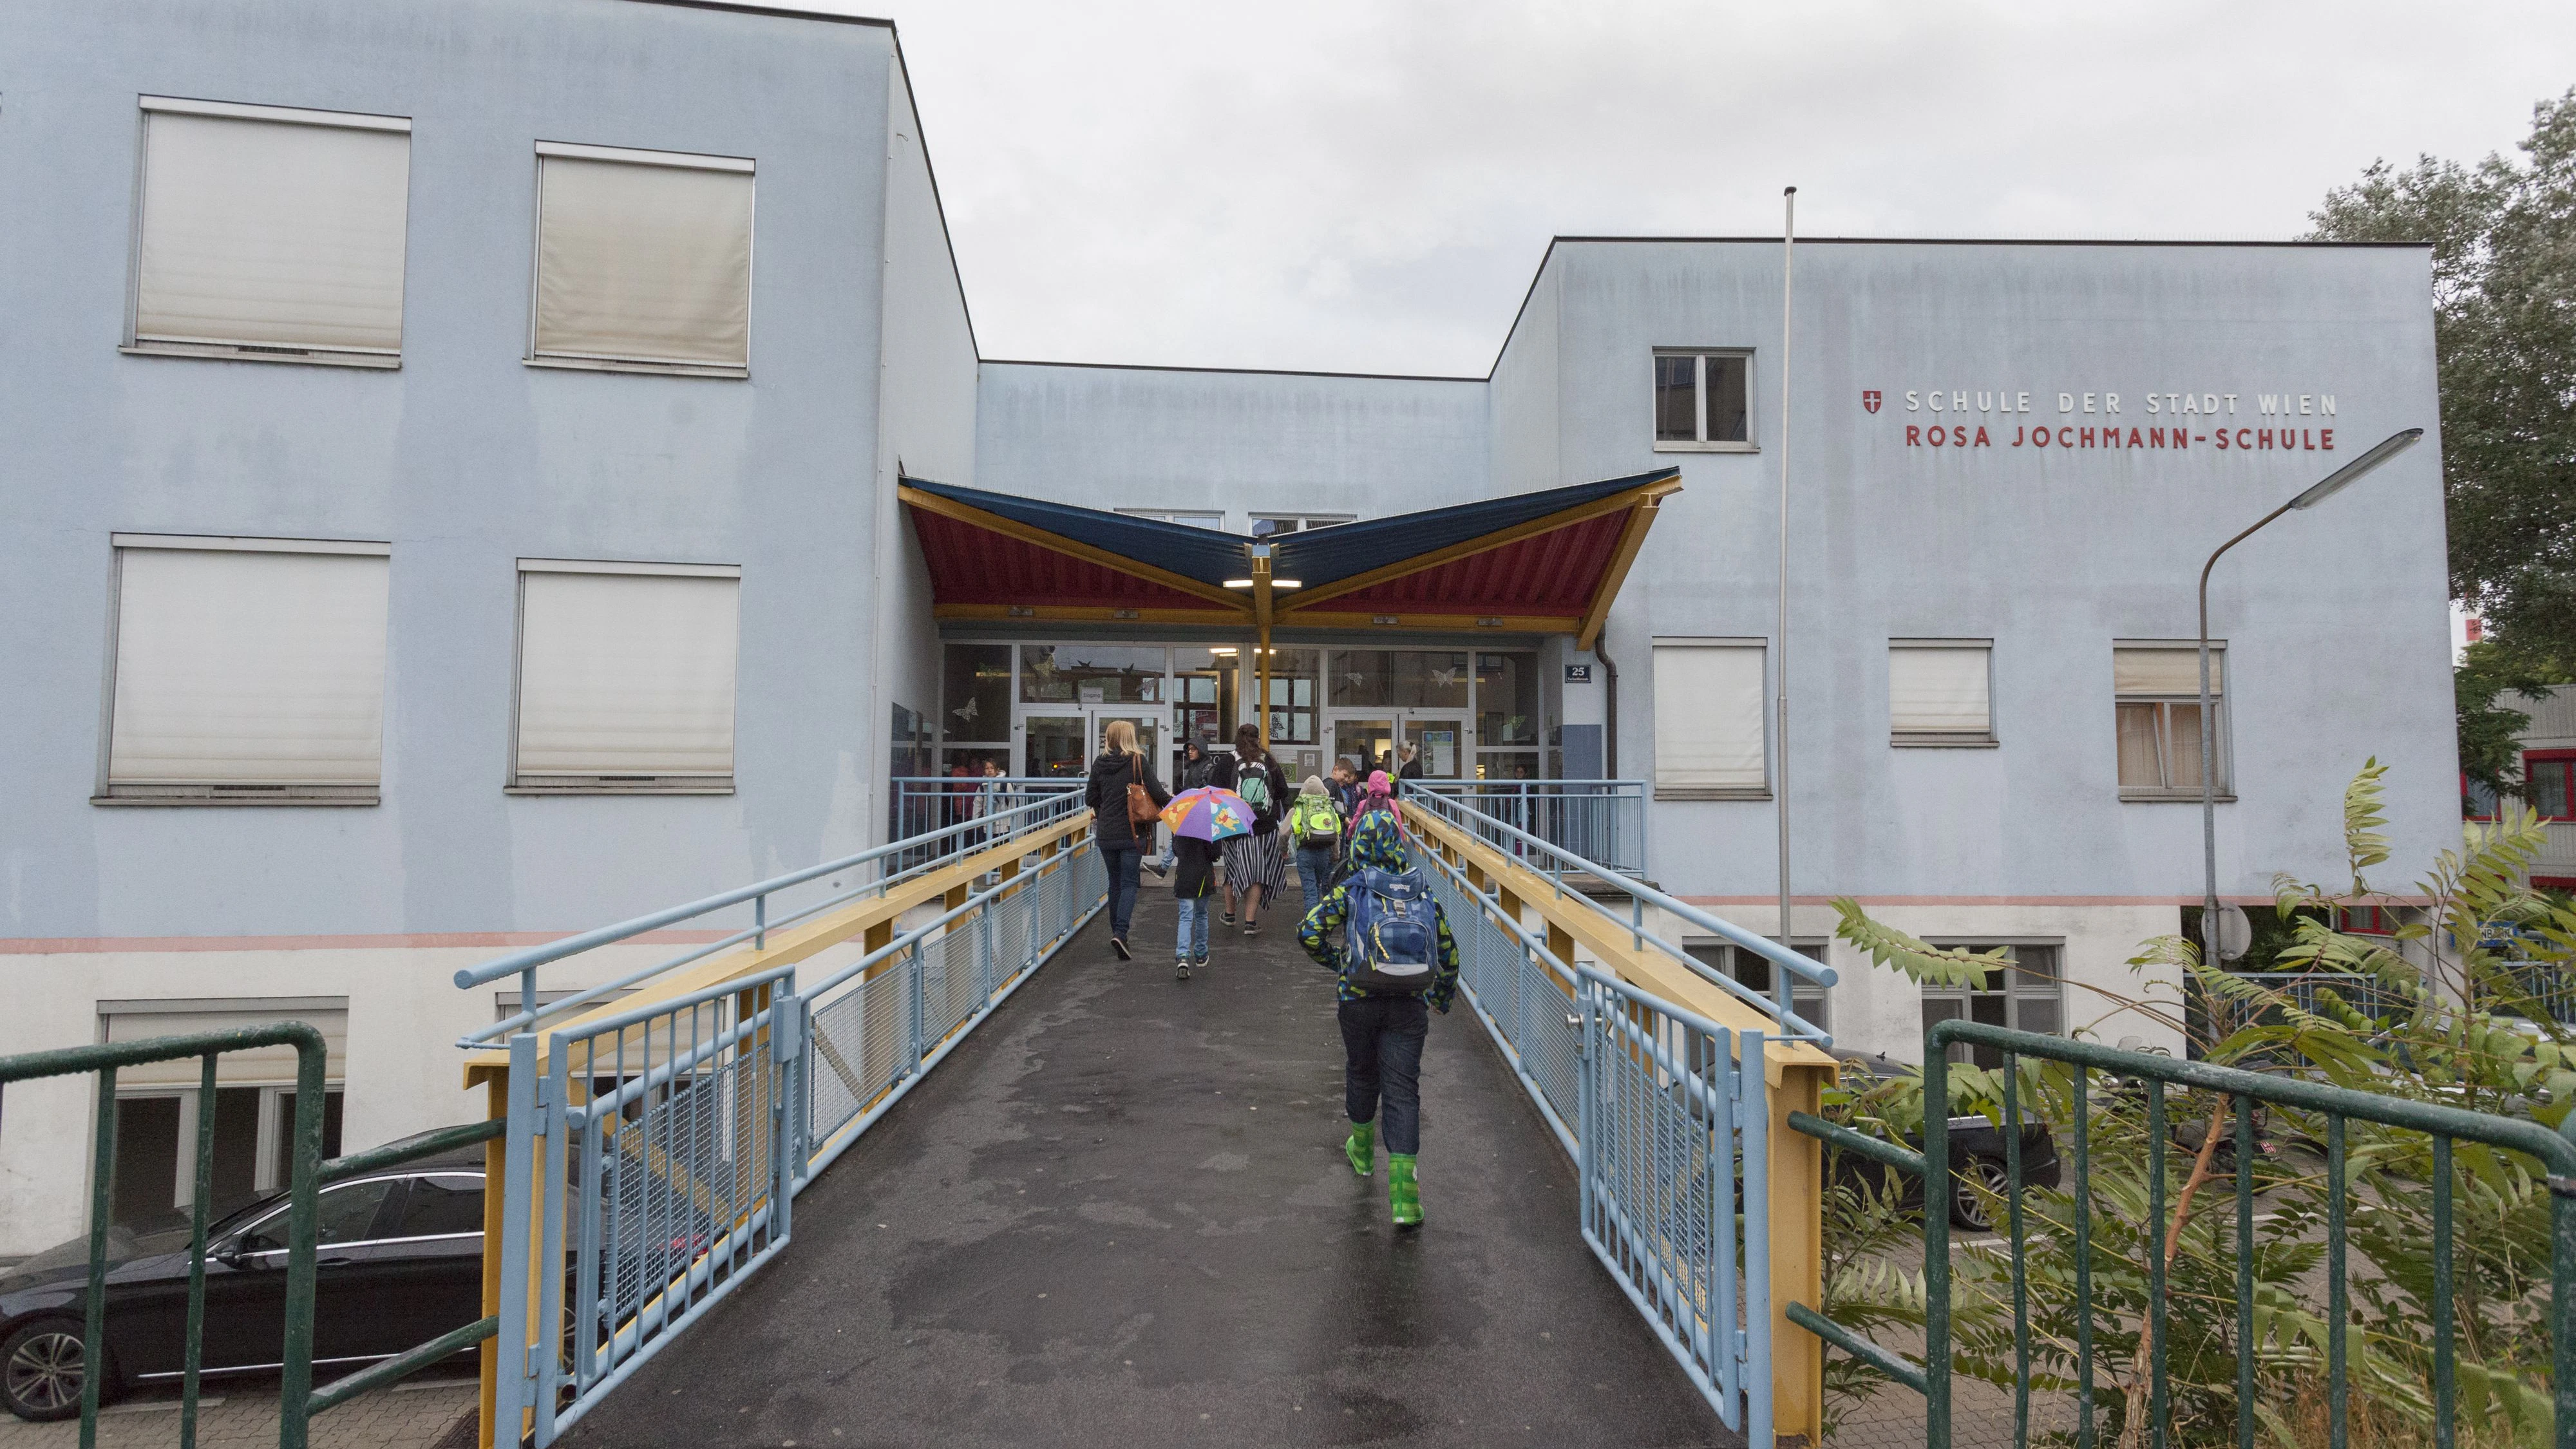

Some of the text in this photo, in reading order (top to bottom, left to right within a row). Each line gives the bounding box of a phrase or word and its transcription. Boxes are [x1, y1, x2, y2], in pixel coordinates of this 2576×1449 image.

[1904, 390, 2336, 415] SCHULE DER STADT WIEN
[1906, 425, 2335, 450] ROSA JOCHMANN-SCHULE
[1572, 667, 1584, 676] 25
